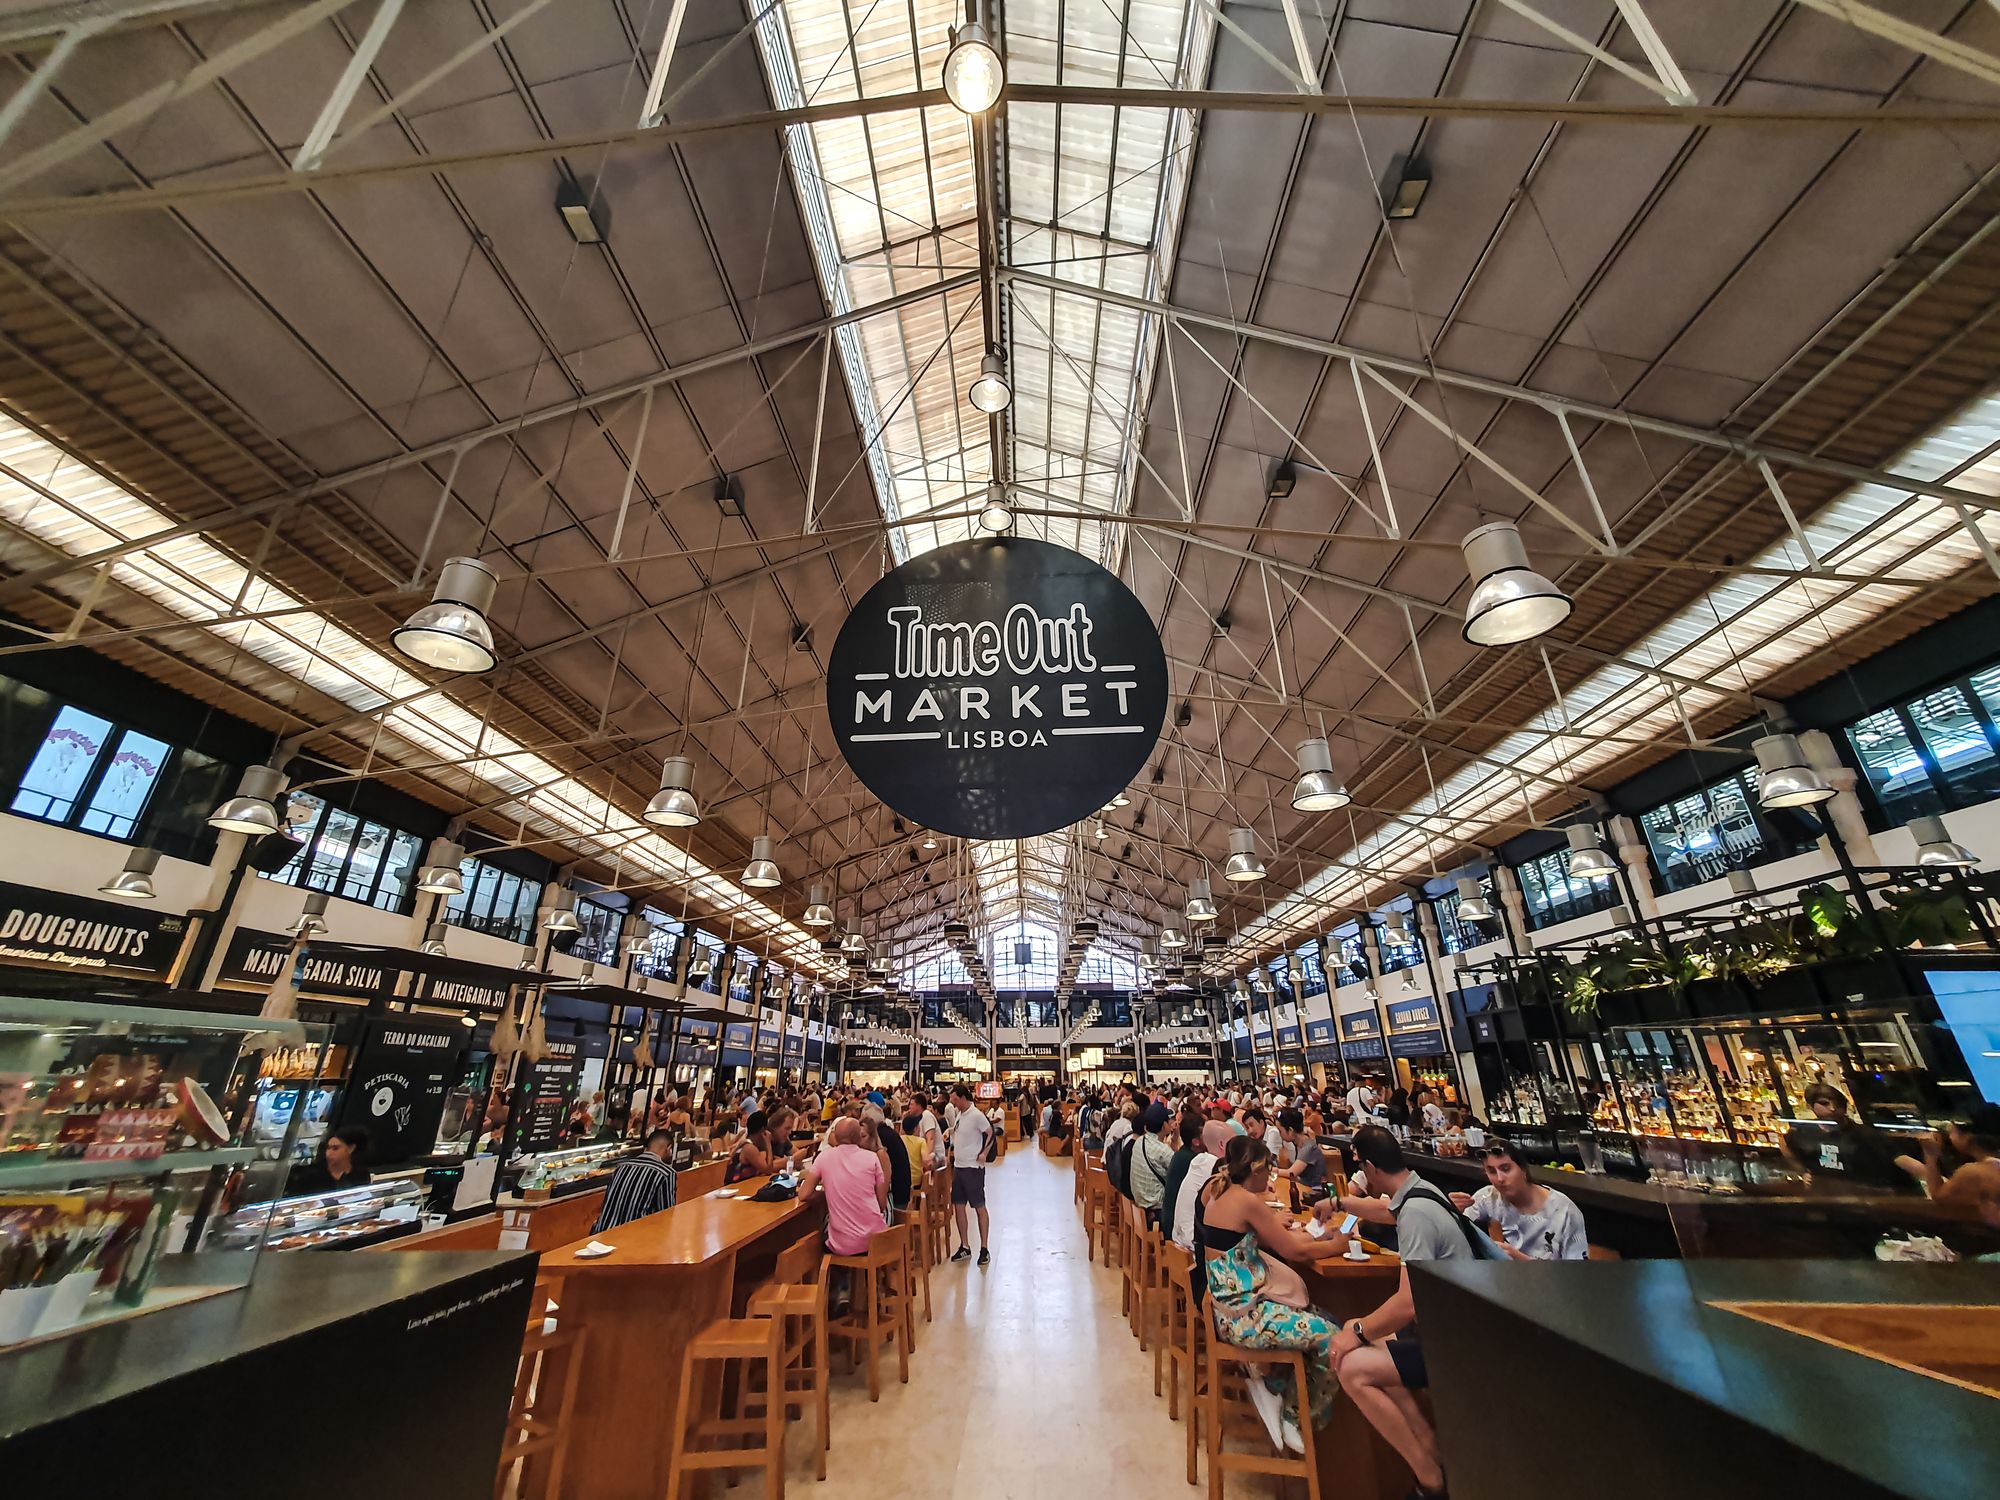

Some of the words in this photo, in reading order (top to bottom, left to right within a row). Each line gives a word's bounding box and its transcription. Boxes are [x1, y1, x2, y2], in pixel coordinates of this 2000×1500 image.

[886, 605, 1001, 679] Time
[1003, 602, 1097, 676] Out
[854, 681, 1137, 724] MARKET
[947, 729, 1049, 749] LISBOA
[0, 909, 149, 957] DOUGHNUTS
[345, 965, 383, 990] SILVA
[431, 980, 492, 1006] MANTEIGARIA
[383, 1031, 406, 1045] TERRA
[406, 1033, 417, 1046] DO
[416, 1034, 451, 1048] BACALHAU
[364, 1073, 410, 1090] PETISCARIA
